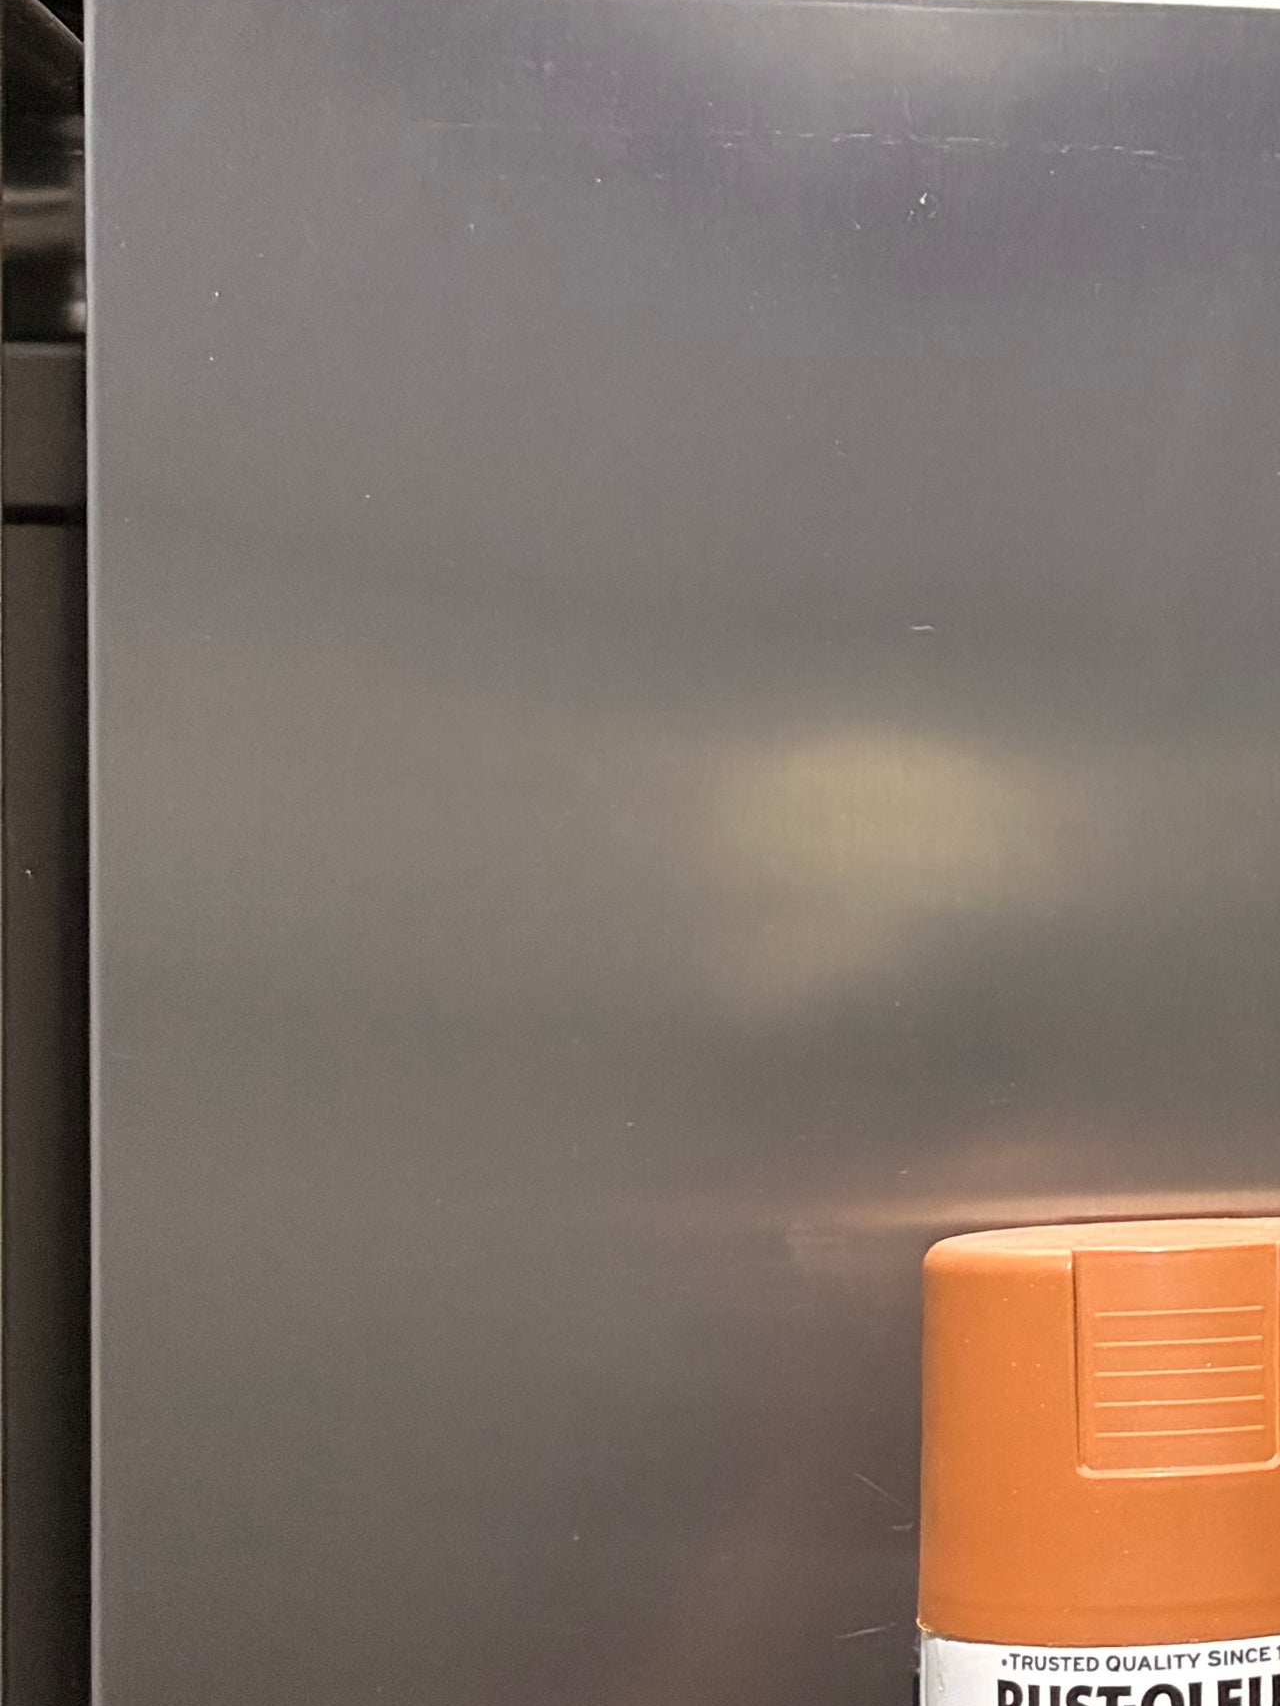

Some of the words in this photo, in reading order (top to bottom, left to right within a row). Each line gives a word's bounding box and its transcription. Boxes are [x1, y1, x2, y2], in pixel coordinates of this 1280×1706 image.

[1007, 1651, 1100, 1673] TRUSTED
[1106, 1650, 1202, 1673] QUALITY
[1208, 1645, 1272, 1668] SINCE
